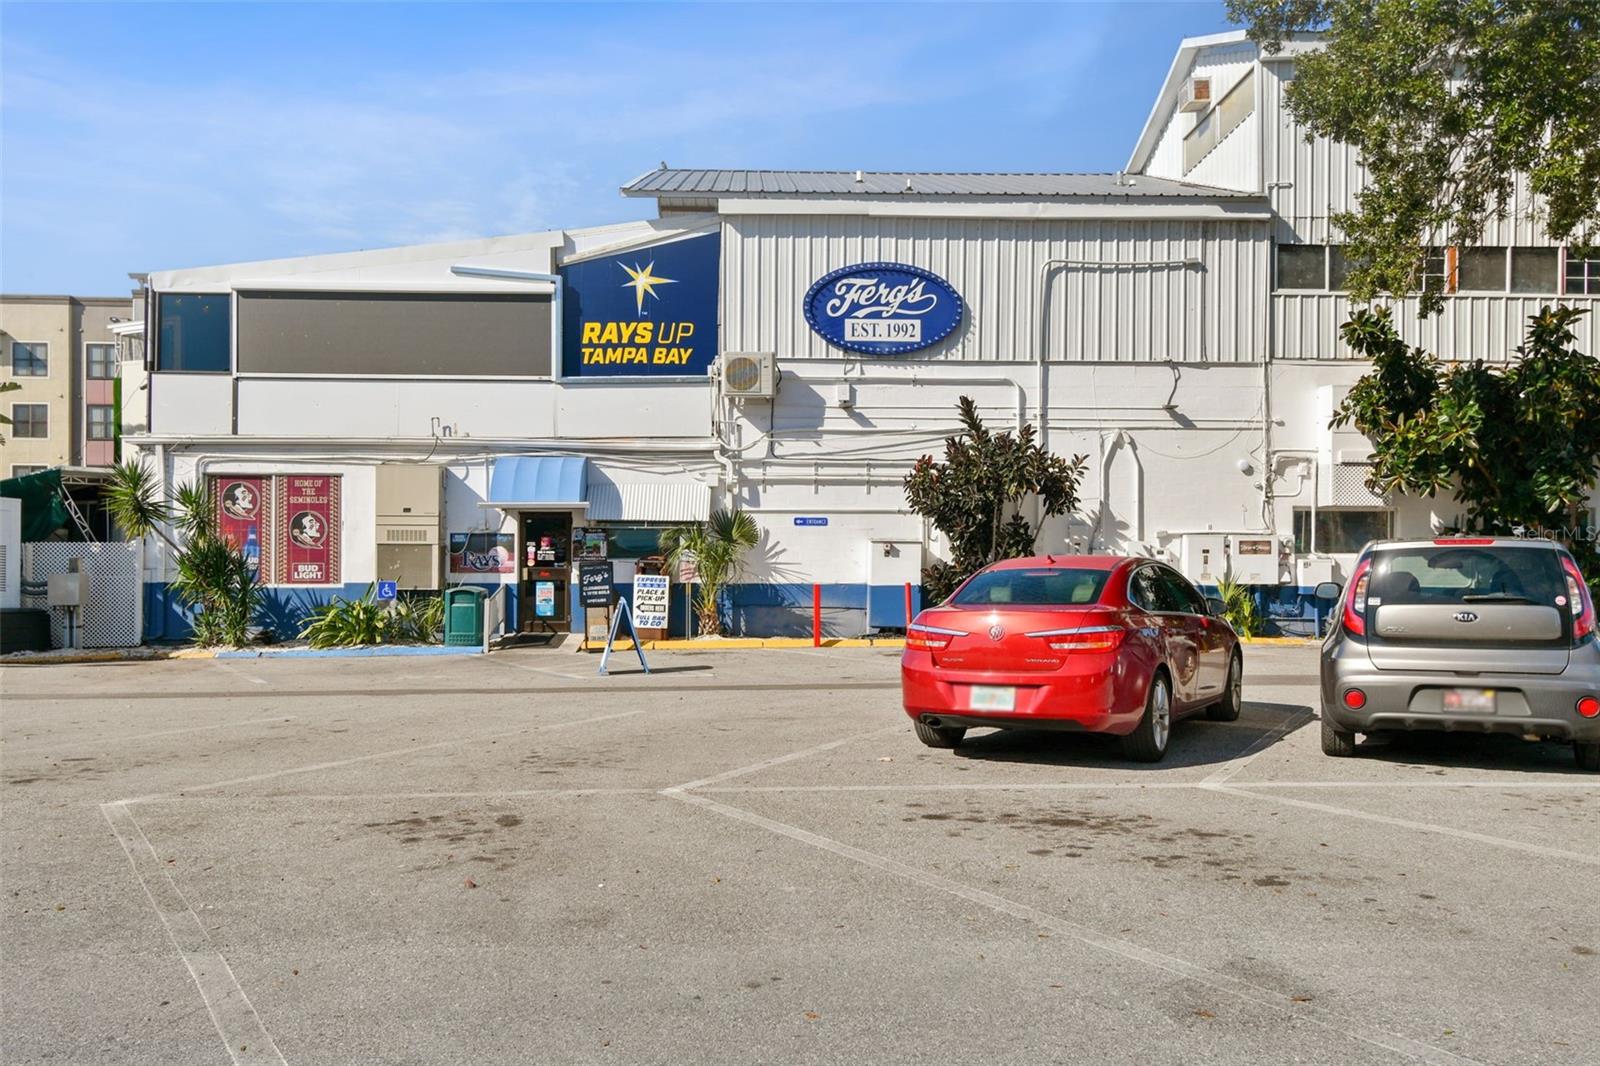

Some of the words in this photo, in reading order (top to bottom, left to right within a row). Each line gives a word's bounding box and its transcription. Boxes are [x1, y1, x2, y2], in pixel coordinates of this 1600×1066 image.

[826, 277, 937, 318] Ferg's
[582, 322, 654, 344] RAYS
[657, 322, 694, 344] UP
[851, 323, 882, 338] EST.
[886, 323, 916, 338] 1992
[581, 347, 648, 364] TAMPA
[652, 347, 693, 364] BAY
[289, 496, 328, 504] SEMINOLES
[298, 564, 319, 572] BUD
[463, 550, 502, 572] RAYS
[294, 571, 322, 579] LIGHT
[583, 571, 609, 585] Ferg's
